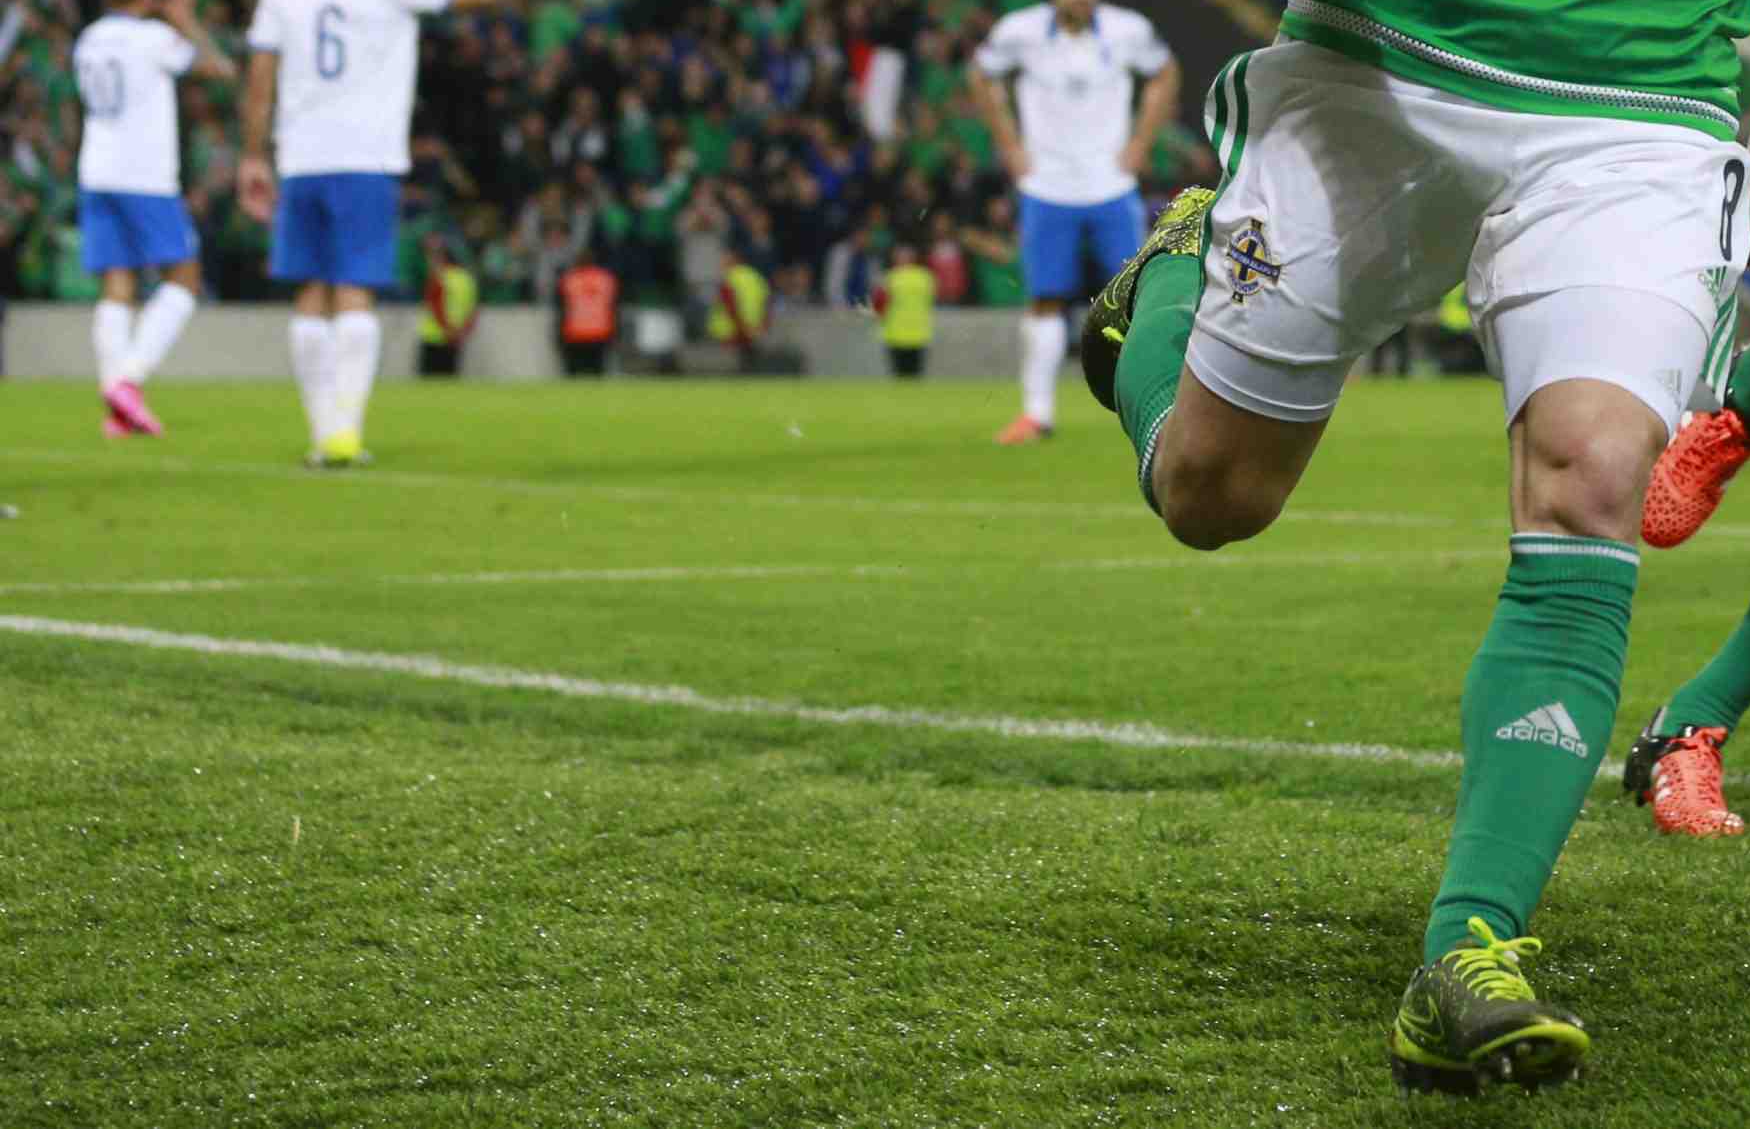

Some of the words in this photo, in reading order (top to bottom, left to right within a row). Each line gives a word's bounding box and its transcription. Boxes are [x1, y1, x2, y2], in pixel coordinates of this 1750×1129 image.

[315, 3, 346, 81] 6
[1720, 158, 1746, 262] 8
[1495, 727, 1589, 759] adidas
